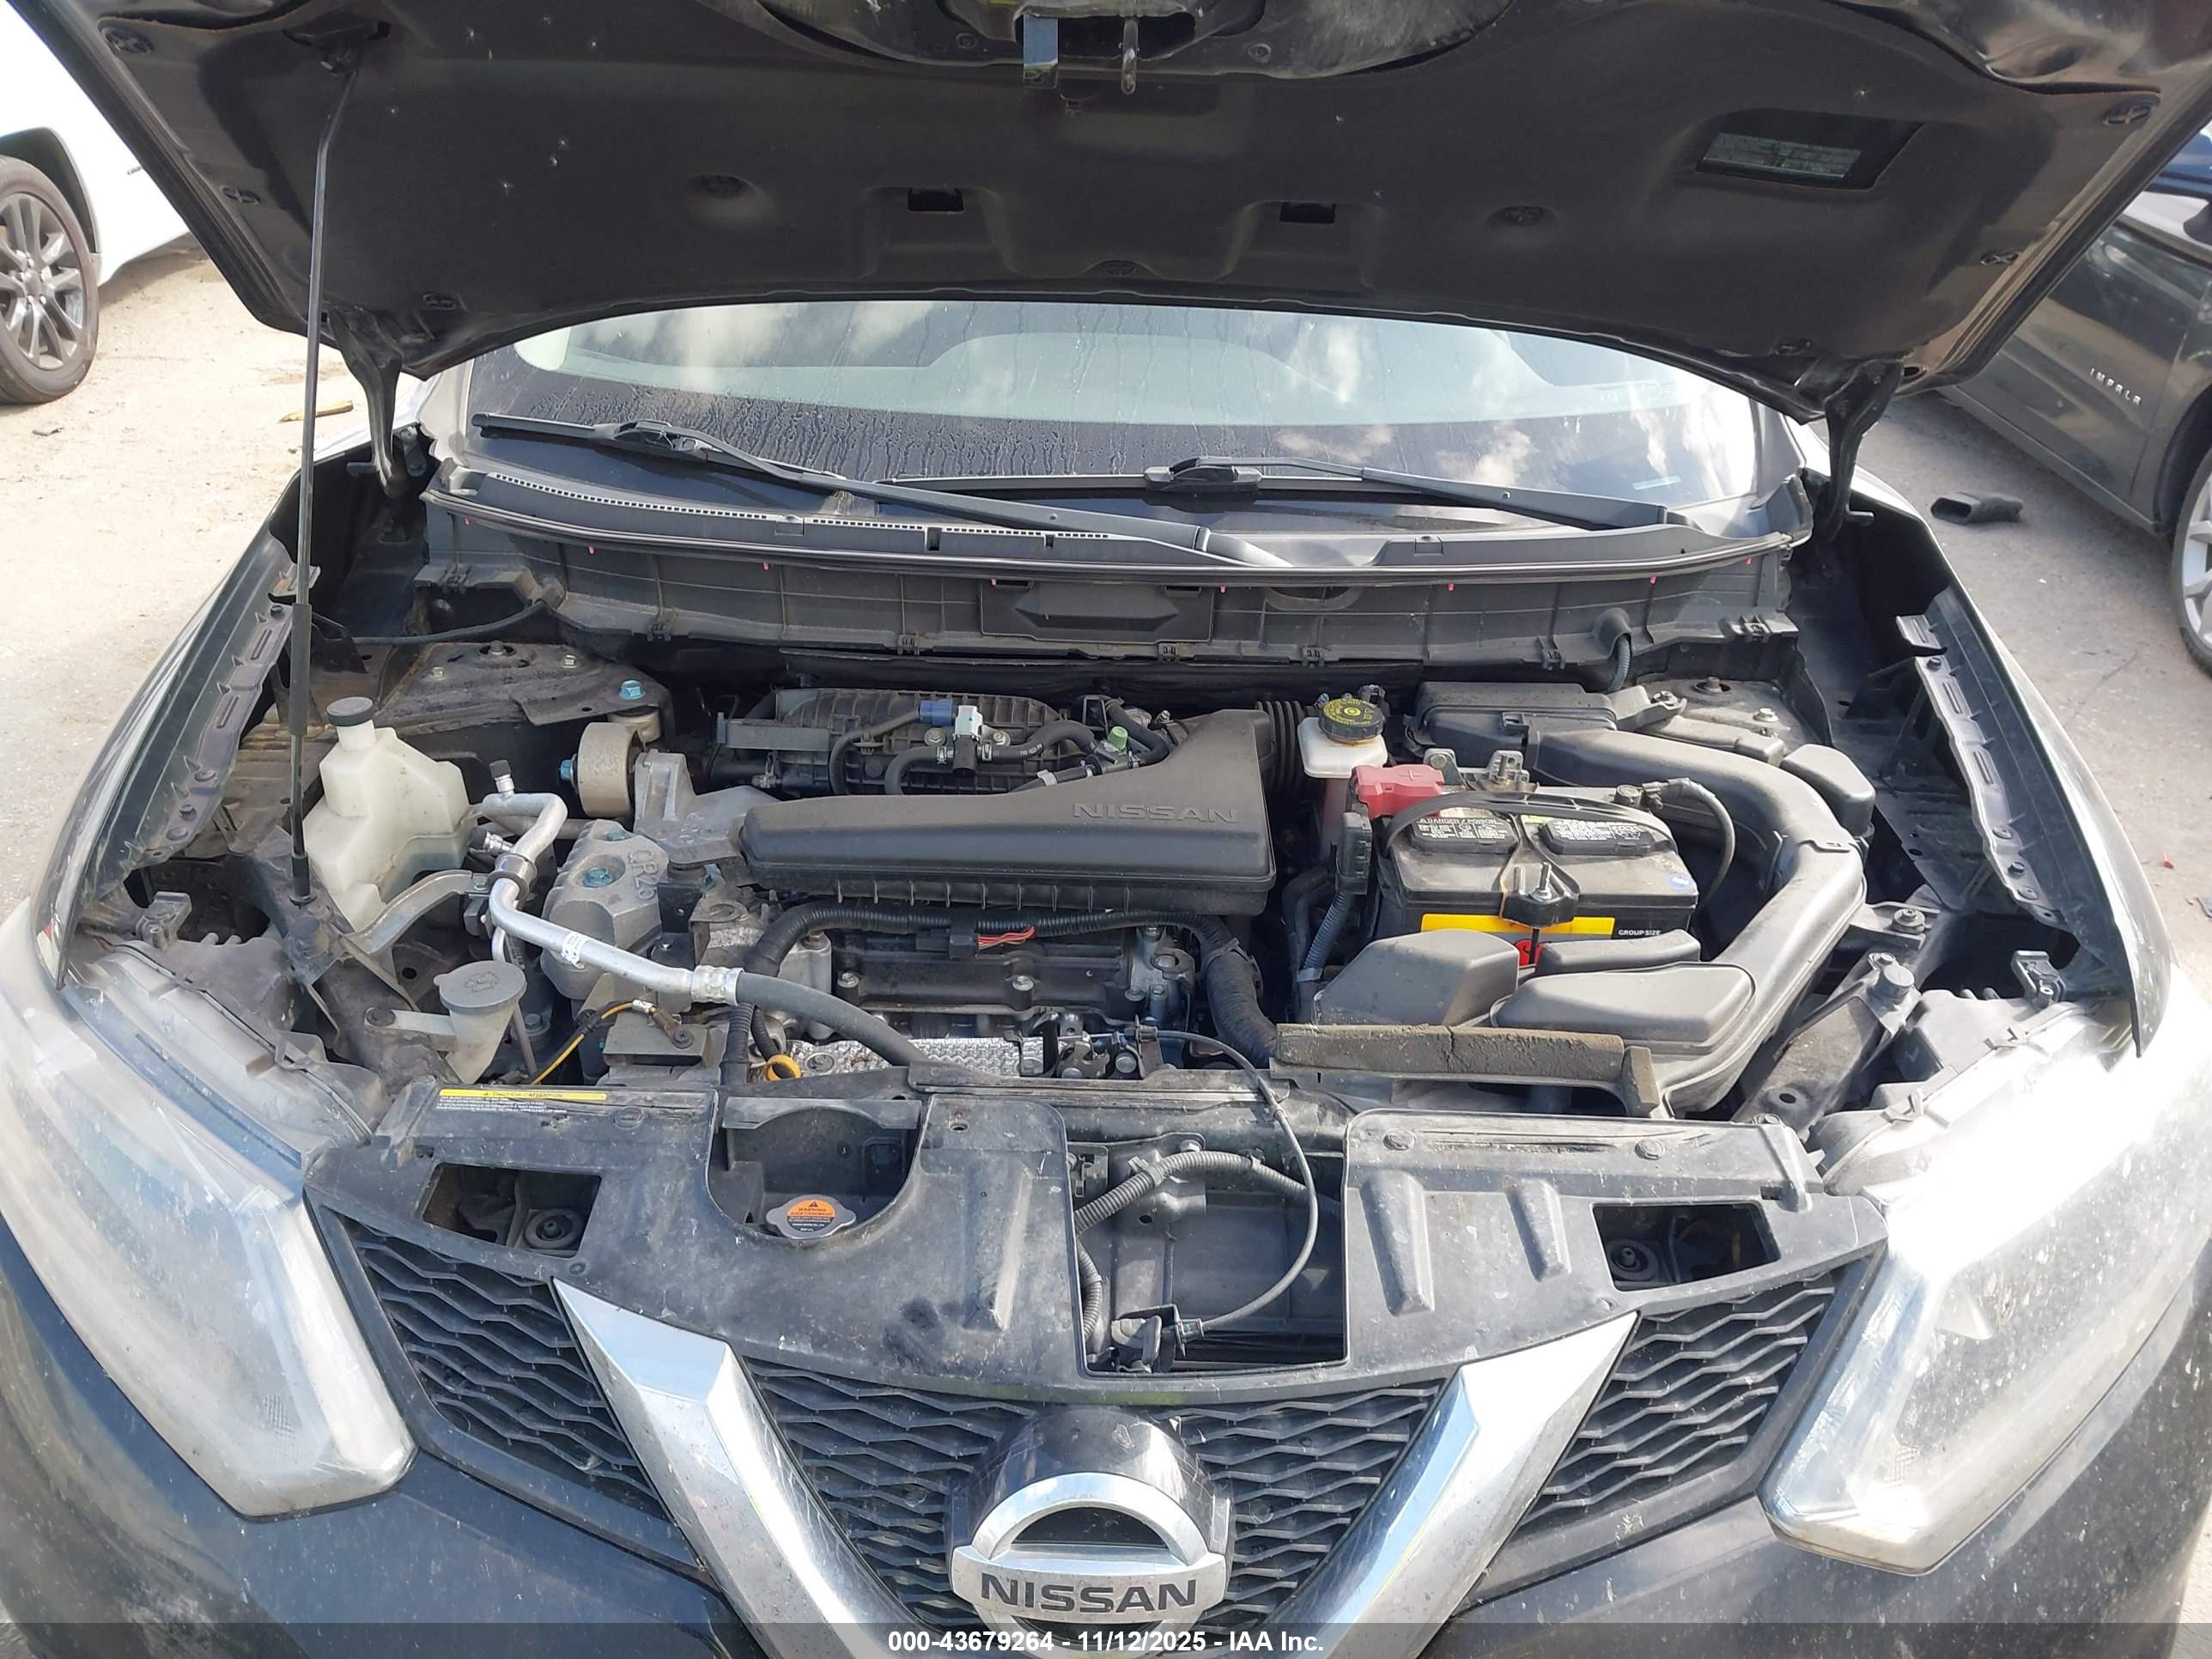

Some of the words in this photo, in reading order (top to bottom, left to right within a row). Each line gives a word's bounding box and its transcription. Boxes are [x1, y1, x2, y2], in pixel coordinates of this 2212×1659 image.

[2088, 368, 2142, 406] IMPALA
[1073, 803, 1237, 823] NISSAN
[981, 1572, 1197, 1613] NISSAN
